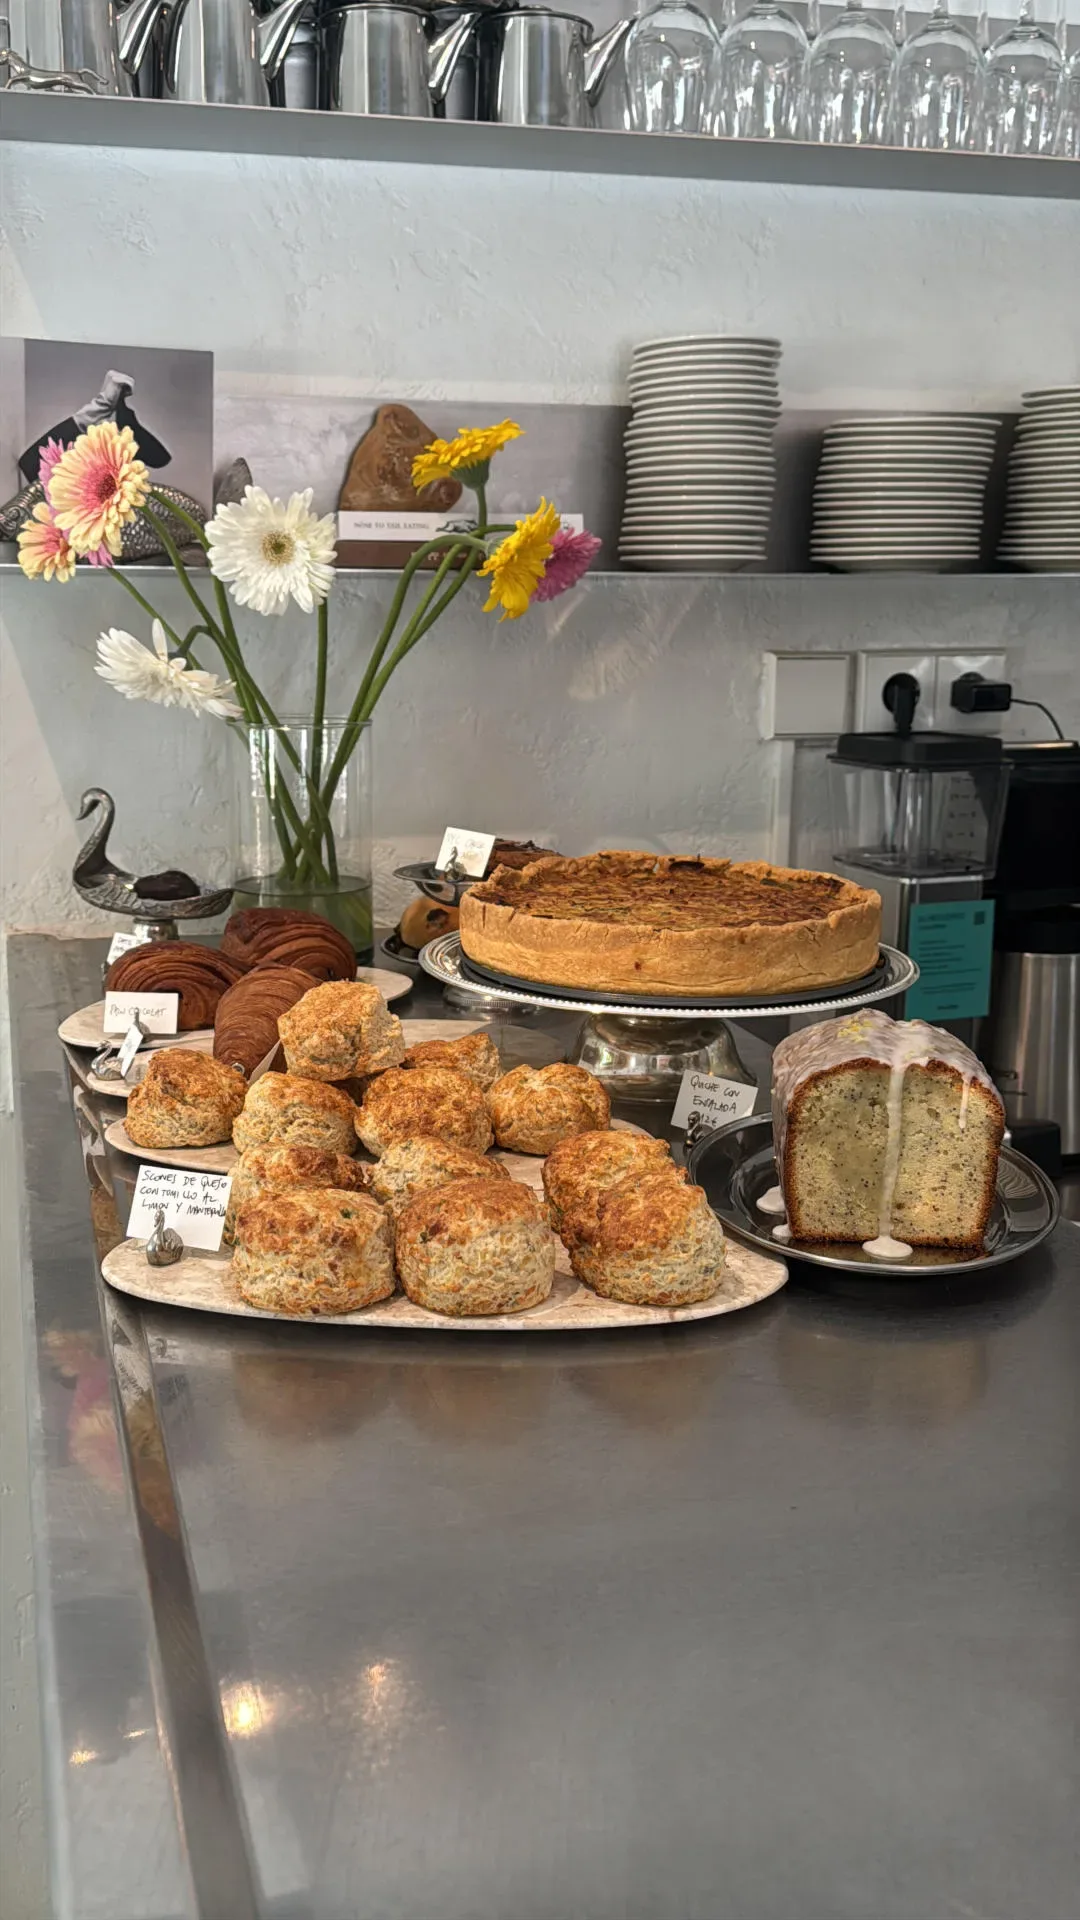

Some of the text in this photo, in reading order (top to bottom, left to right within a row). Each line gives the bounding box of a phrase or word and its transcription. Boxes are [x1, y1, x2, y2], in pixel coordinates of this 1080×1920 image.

[723, 1087, 741, 1097] CON
[142, 1170, 177, 1184] SCONES
[182, 1176, 197, 1186] DE
[140, 1186, 159, 1195] CON
[203, 1192, 218, 1204] AL
[176, 1202, 183, 1213] Y
